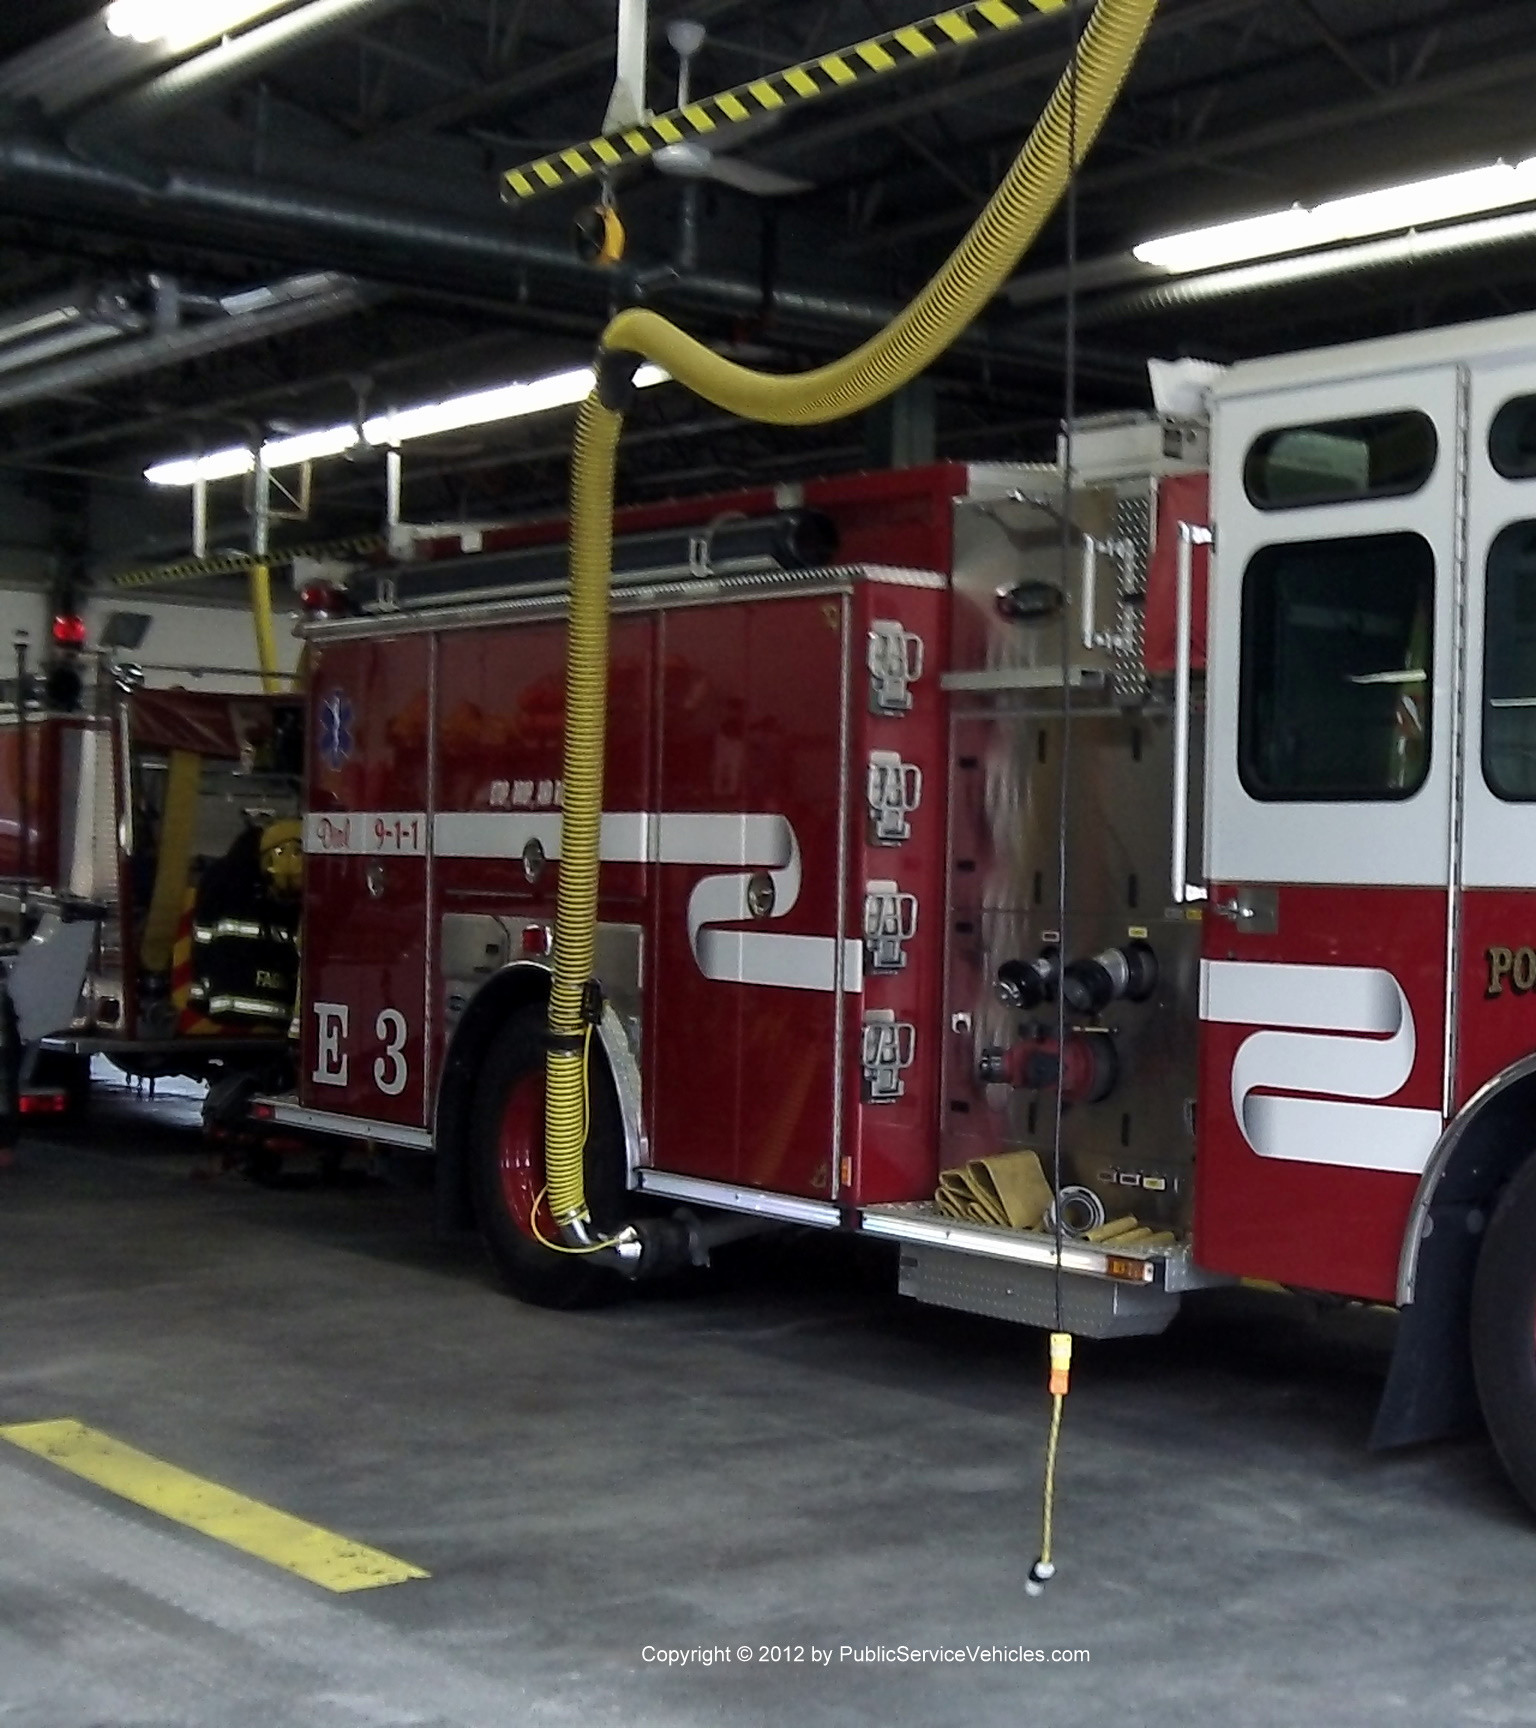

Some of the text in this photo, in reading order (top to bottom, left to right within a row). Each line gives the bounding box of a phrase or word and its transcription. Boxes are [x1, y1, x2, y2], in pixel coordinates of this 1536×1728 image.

[375, 818, 418, 850] 9-1-1
[312, 1002, 407, 1096] E 3
